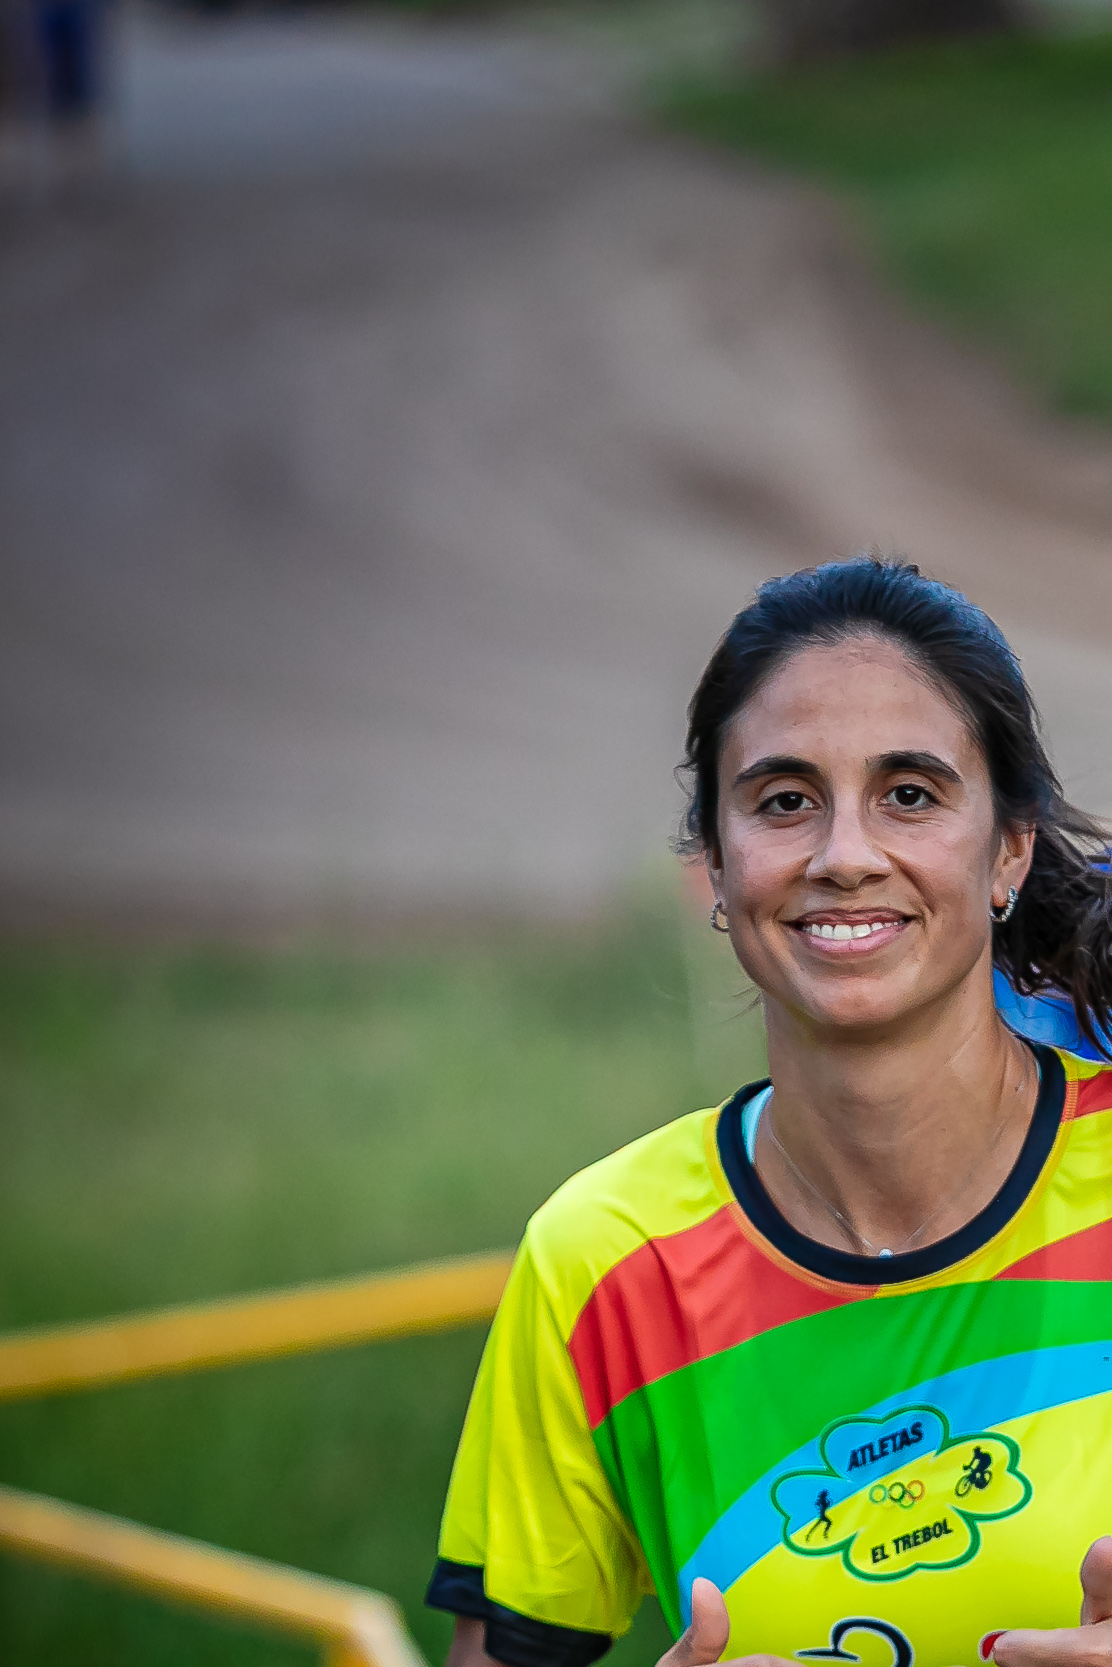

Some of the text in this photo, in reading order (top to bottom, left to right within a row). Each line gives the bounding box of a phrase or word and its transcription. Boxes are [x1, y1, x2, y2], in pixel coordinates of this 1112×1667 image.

[847, 1421, 923, 1472] ATLETAS
[871, 1517, 953, 1564] EL TREBOL
